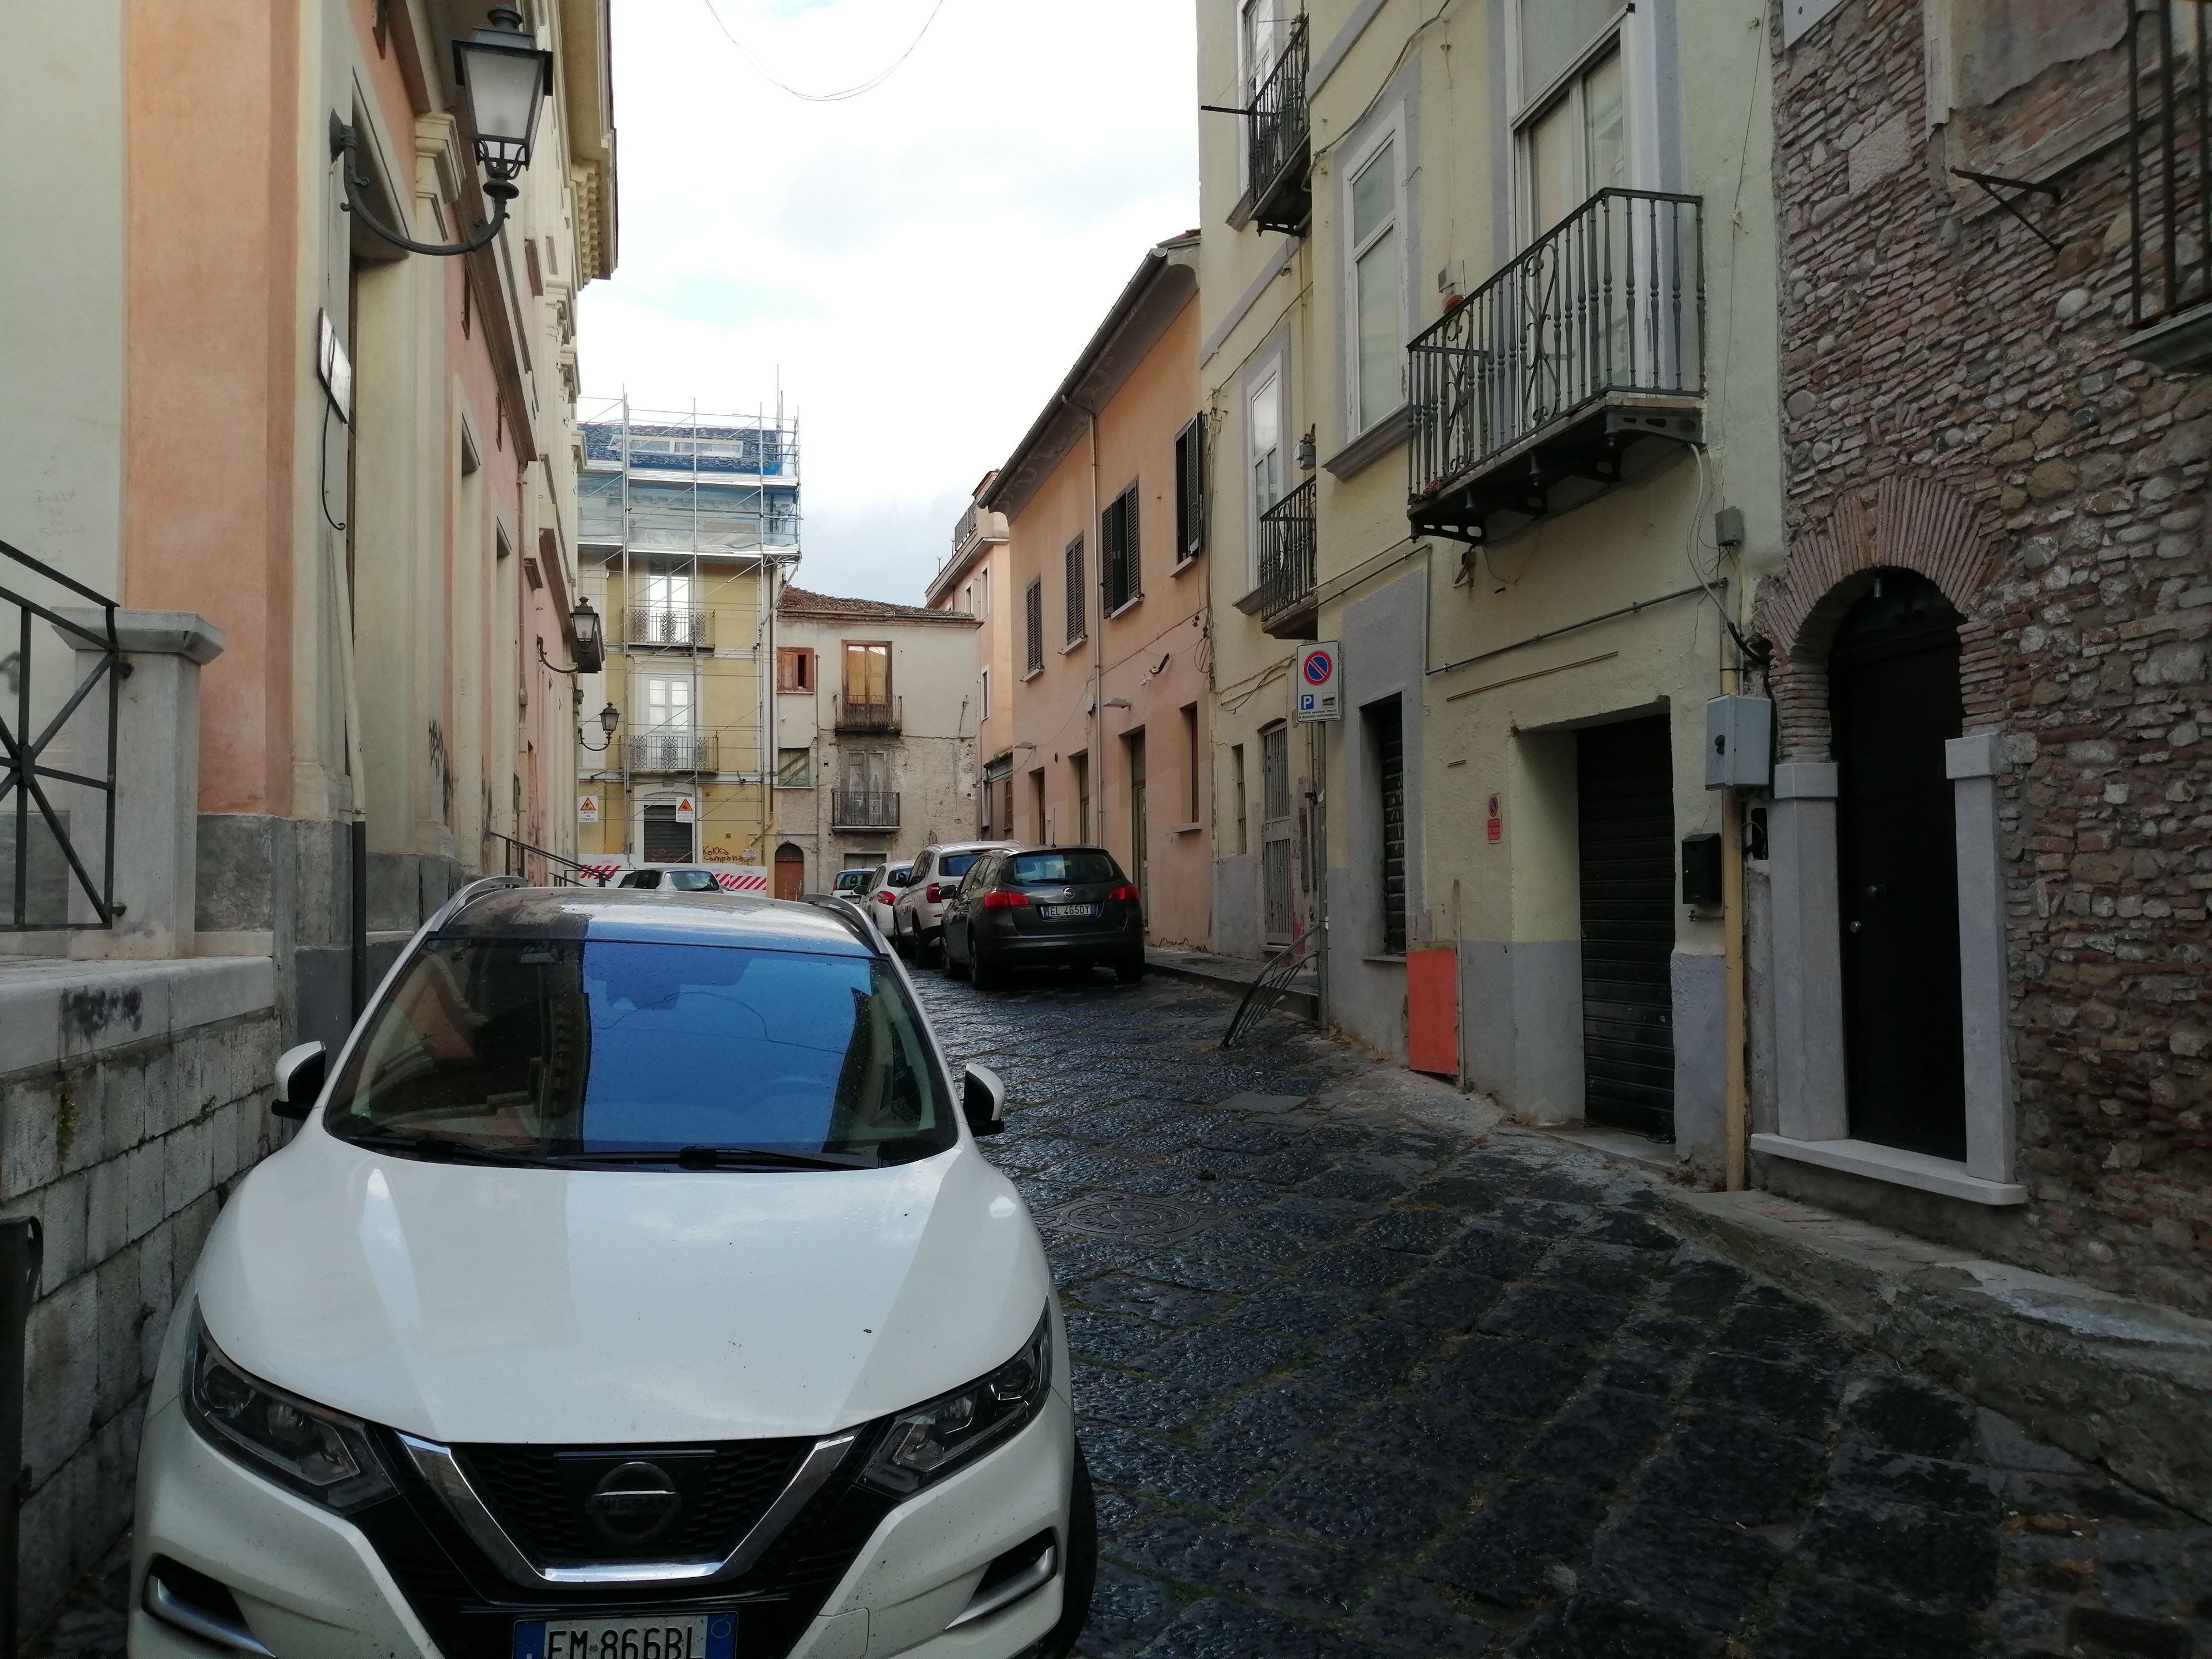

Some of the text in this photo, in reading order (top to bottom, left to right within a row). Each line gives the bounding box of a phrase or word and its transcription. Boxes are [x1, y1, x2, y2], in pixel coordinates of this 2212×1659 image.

[1303, 695, 1312, 709] P
[1050, 905, 1089, 915] EL 465DY
